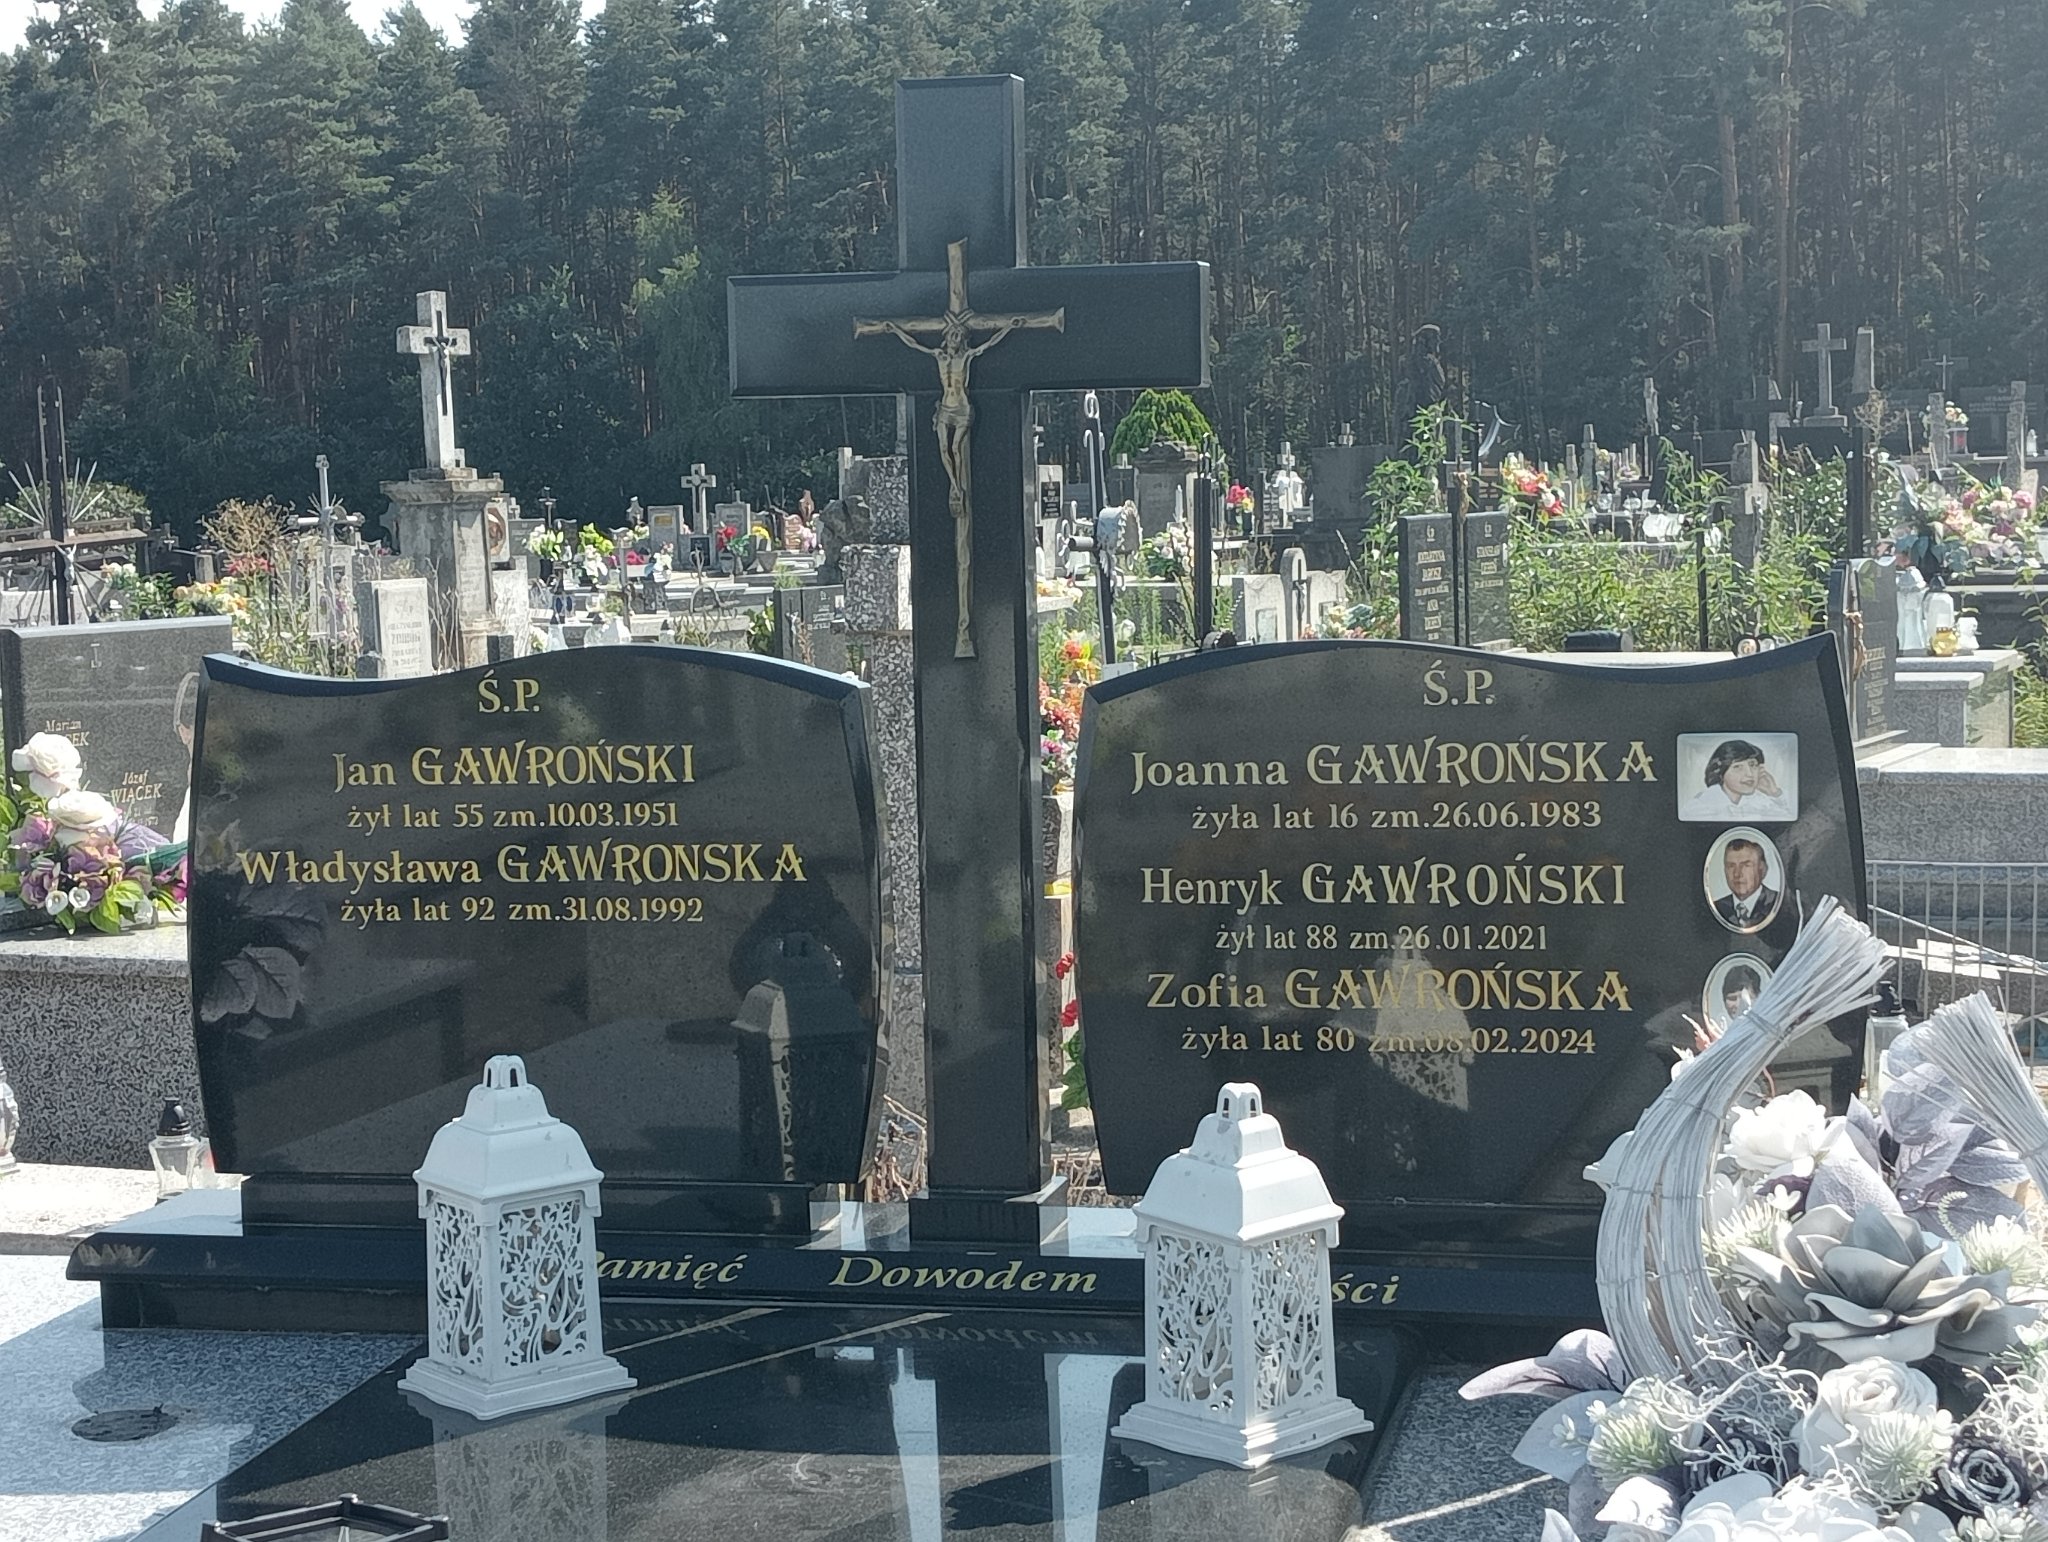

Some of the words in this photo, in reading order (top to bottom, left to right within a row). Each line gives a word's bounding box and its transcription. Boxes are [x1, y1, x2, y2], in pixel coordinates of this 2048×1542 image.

[478, 668, 540, 713] Ś.P.
[1422, 659, 1495, 706] Ś.P.
[332, 753, 397, 793] Jan
[411, 738, 696, 788] GAWROŃSKI
[1130, 751, 1289, 795] Joanna
[1306, 735, 1658, 788] GAWROŃSKA
[346, 803, 392, 837] żył
[402, 803, 441, 828] lat
[452, 803, 485, 828] 55
[493, 802, 680, 828] zm.10.03.1951
[1191, 805, 1260, 839] żyła
[1272, 803, 1315, 829] lat
[1328, 803, 1359, 829] 16
[1370, 801, 1602, 829] zm.26.06.1983
[235, 849, 483, 896] Władysława
[1139, 867, 1284, 916] Henryk
[1301, 852, 1627, 908] GAWROŃSKI
[340, 899, 402, 931] żyła
[411, 897, 451, 922] lat
[461, 896, 496, 922] 92
[508, 896, 704, 923] zm.31.08.1992
[1215, 923, 1256, 956] żył
[1264, 924, 1297, 950] lat
[1306, 924, 1338, 950] 88
[1349, 924, 1548, 951] zm.26.01.2021
[1146, 972, 1268, 1009] Zofia
[1284, 961, 1634, 1013] GAWROŃSKA
[1181, 1026, 1249, 1060] żyła
[1261, 1025, 1304, 1052] lat
[1316, 1026, 1356, 1053] 80
[828, 1256, 1098, 1294] Dowodem
